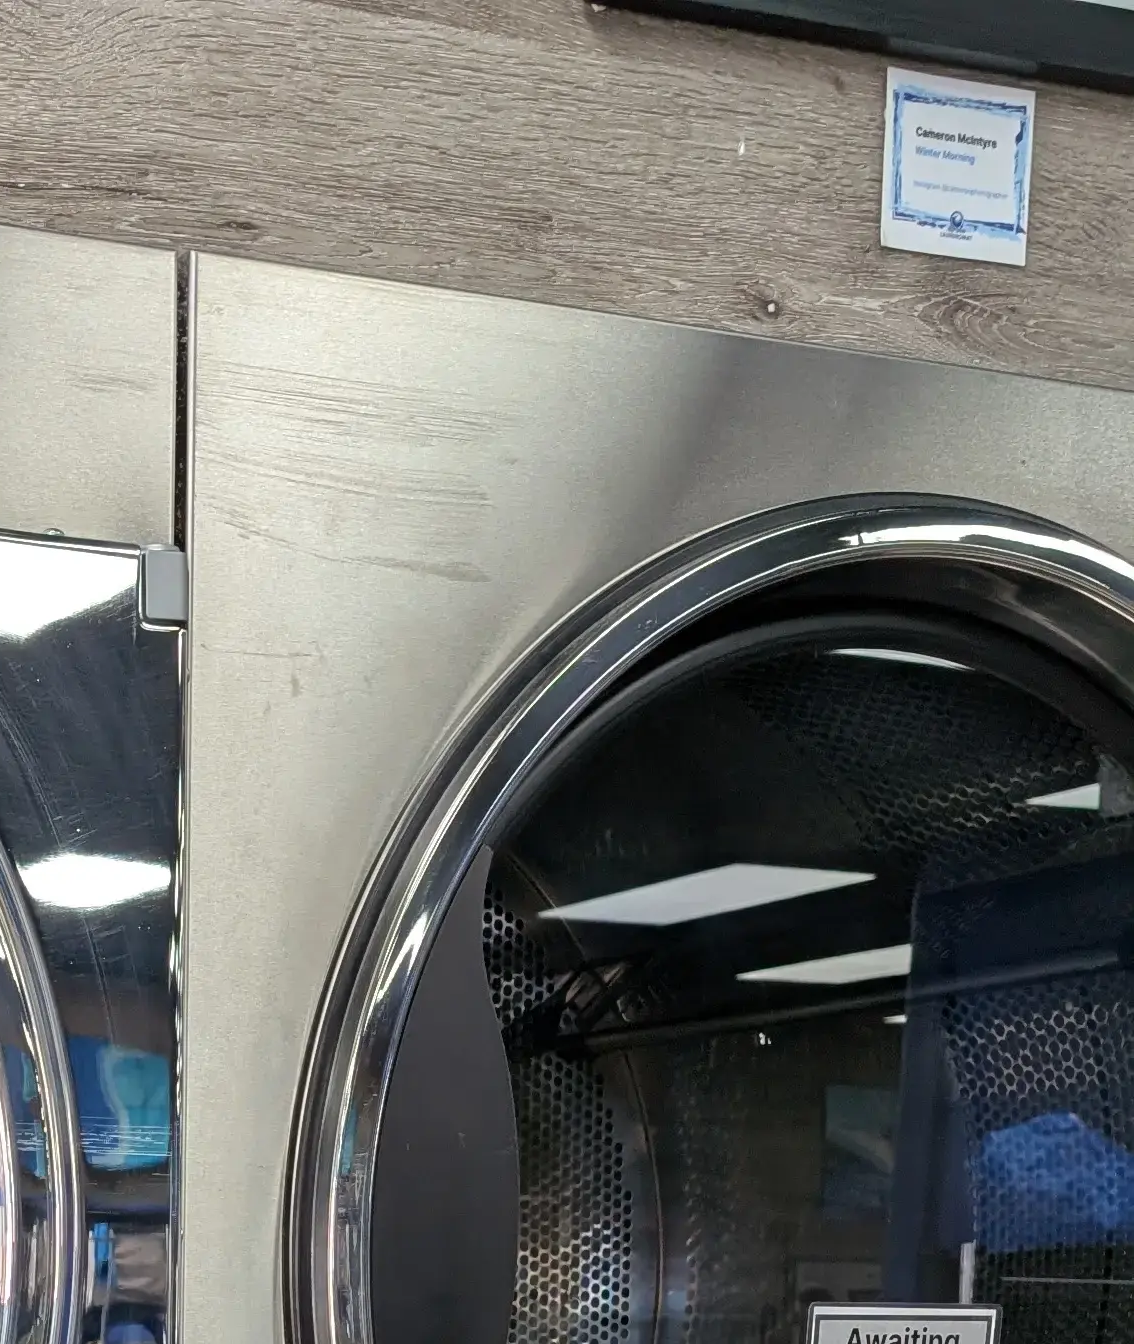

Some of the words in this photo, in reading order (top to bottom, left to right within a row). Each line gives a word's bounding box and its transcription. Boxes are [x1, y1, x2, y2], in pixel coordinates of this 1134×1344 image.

[916, 126, 956, 142] Cameron
[916, 145, 941, 158] Winter
[942, 150, 975, 166] Morning
